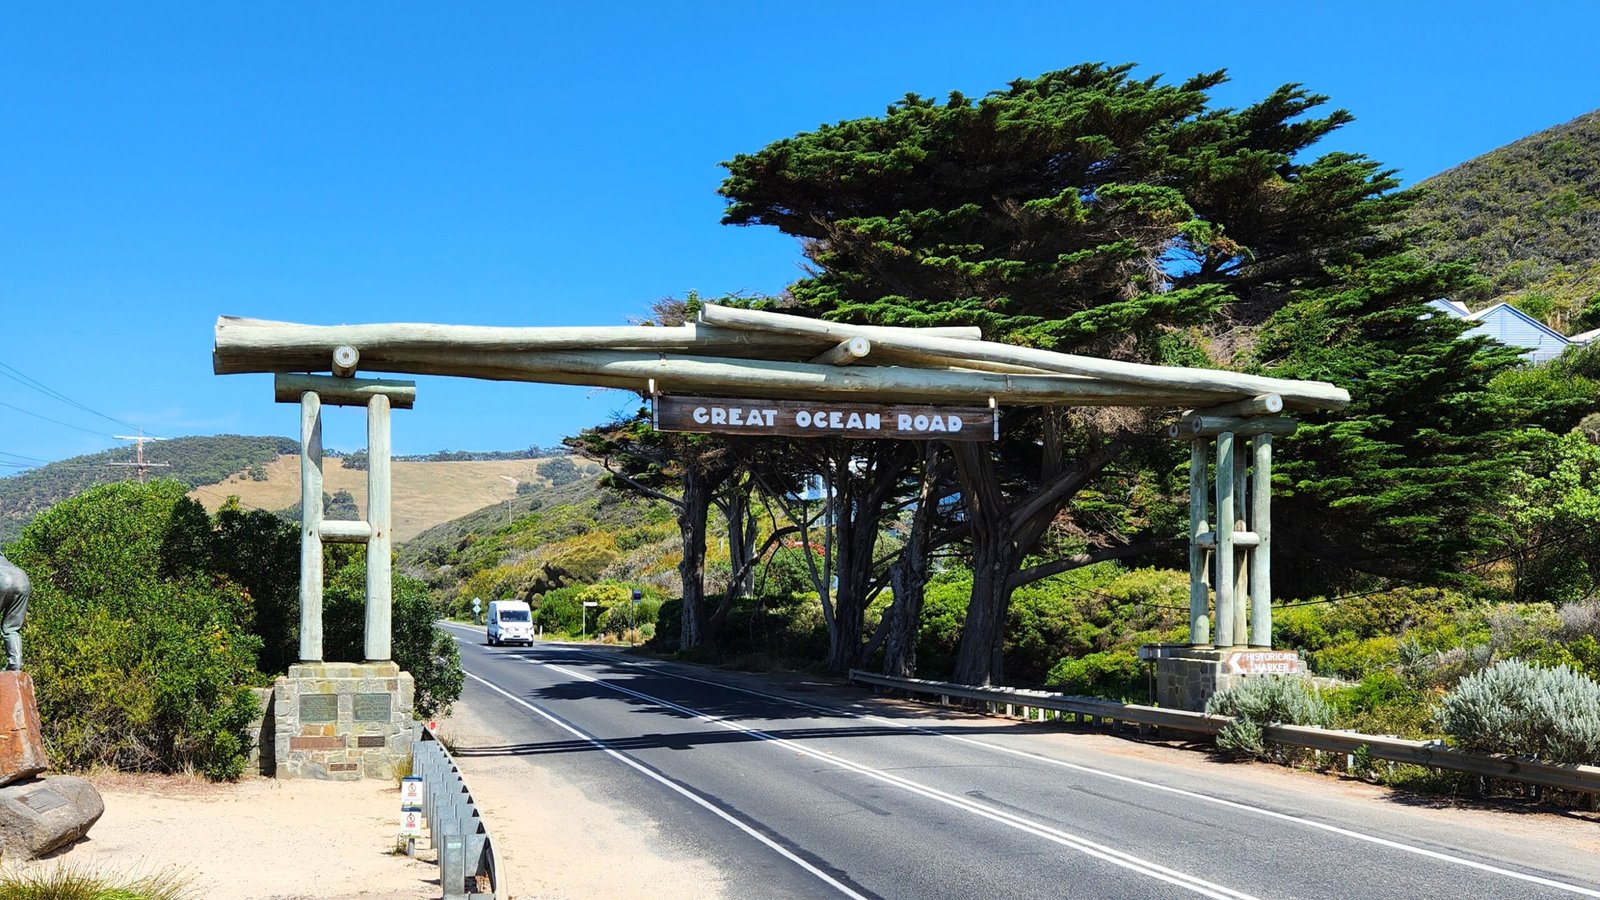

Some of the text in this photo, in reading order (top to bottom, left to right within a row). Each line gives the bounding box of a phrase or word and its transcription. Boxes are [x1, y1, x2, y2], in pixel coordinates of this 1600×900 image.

[692, 407, 963, 432] GREAT OCEAN ROAD
[1246, 652, 1297, 661] HISTORICAL
[1254, 663, 1288, 672] MARKER
